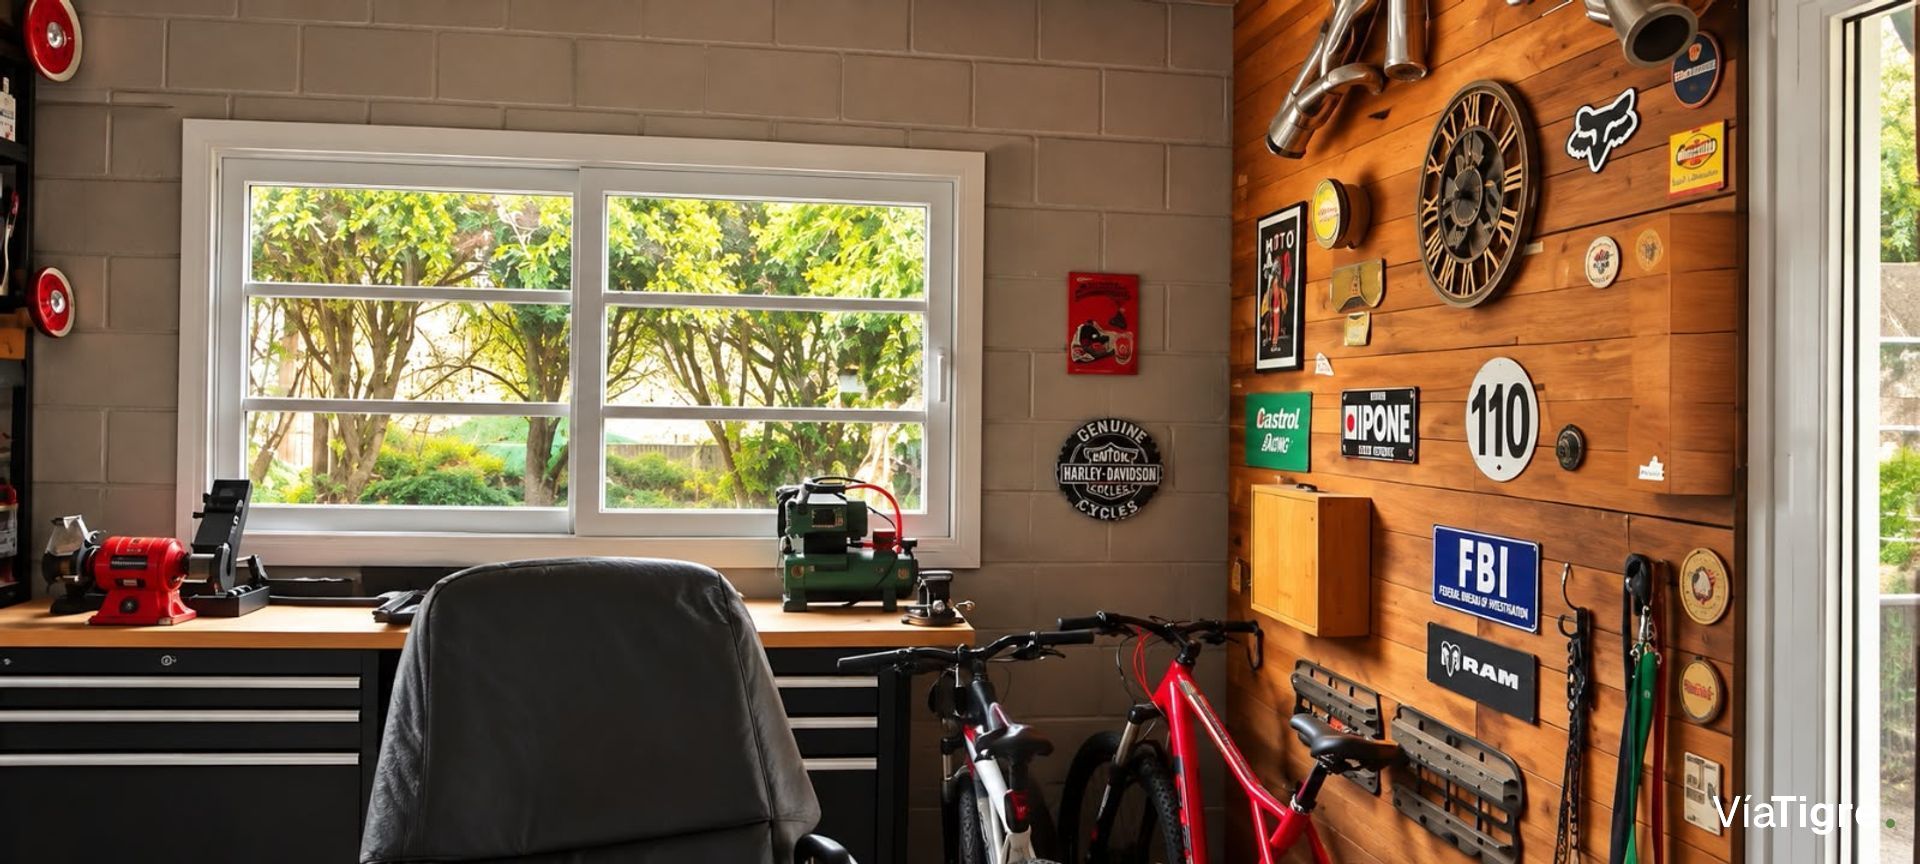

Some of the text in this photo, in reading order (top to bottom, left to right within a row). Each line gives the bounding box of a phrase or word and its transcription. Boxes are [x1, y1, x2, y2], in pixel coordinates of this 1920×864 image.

[1077, 419, 1148, 444] GENUINE
[1256, 407, 1301, 429] Castrol
[1358, 404, 1411, 443] IPONE
[1471, 382, 1530, 459] 110
[1064, 466, 1157, 481] HARLEY-DAVIDSON
[1077, 500, 1138, 519] CYCLES
[1458, 537, 1509, 599] FBI
[1463, 654, 1519, 690] RAM
